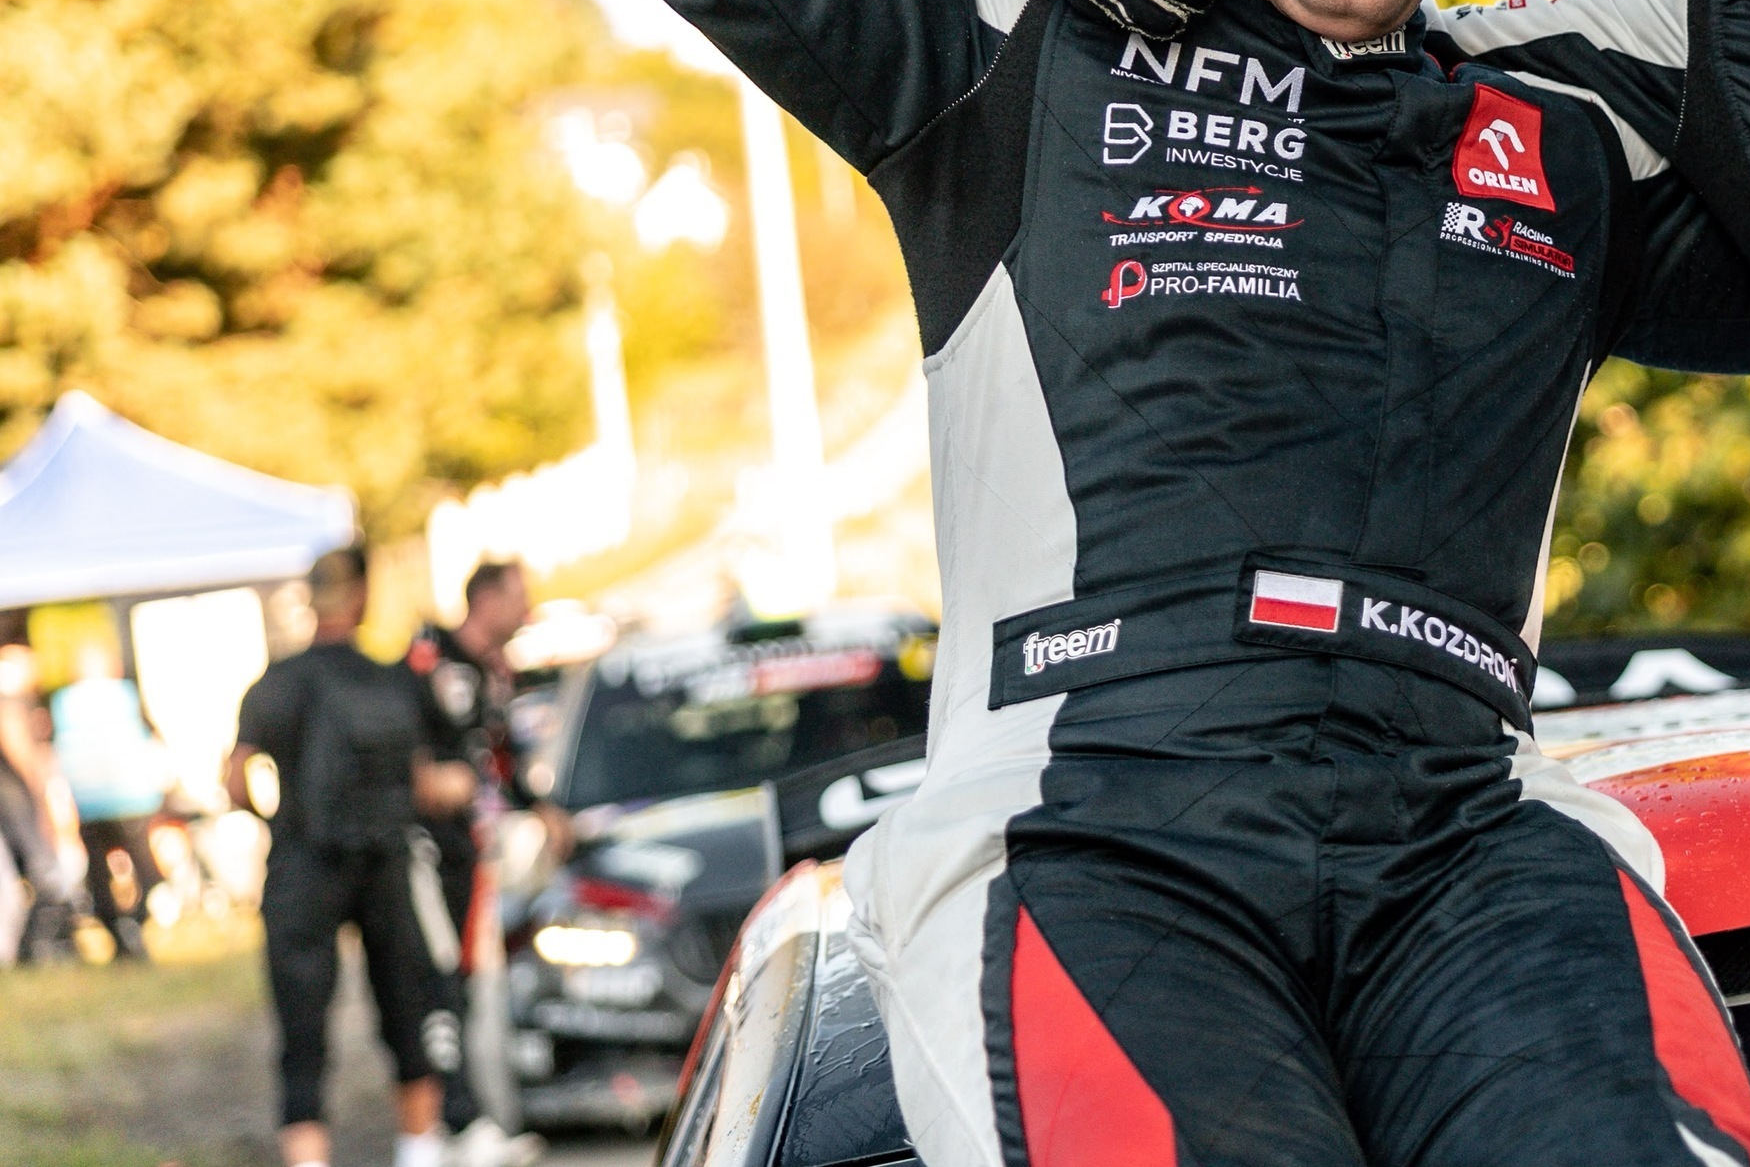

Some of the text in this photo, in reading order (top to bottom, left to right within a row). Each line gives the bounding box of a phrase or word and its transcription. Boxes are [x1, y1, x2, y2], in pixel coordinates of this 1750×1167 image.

[1119, 32, 1306, 113] NFM
[1167, 110, 1308, 160] BERG
[1166, 147, 1304, 182] INWESTYCJE
[1468, 167, 1539, 196] ORLEN
[1109, 230, 1284, 249] TRANSPORT SPEDYCJA
[1512, 221, 1553, 245] RACING
[1440, 232, 1503, 255] PROFESSIONAL
[1505, 249, 1542, 267] TRAINING
[1151, 262, 1300, 279] SZPITAL SPECJALISTYCZNY
[1150, 275, 1302, 302] PRO-FAMILIA
[1023, 622, 1119, 675] freem
